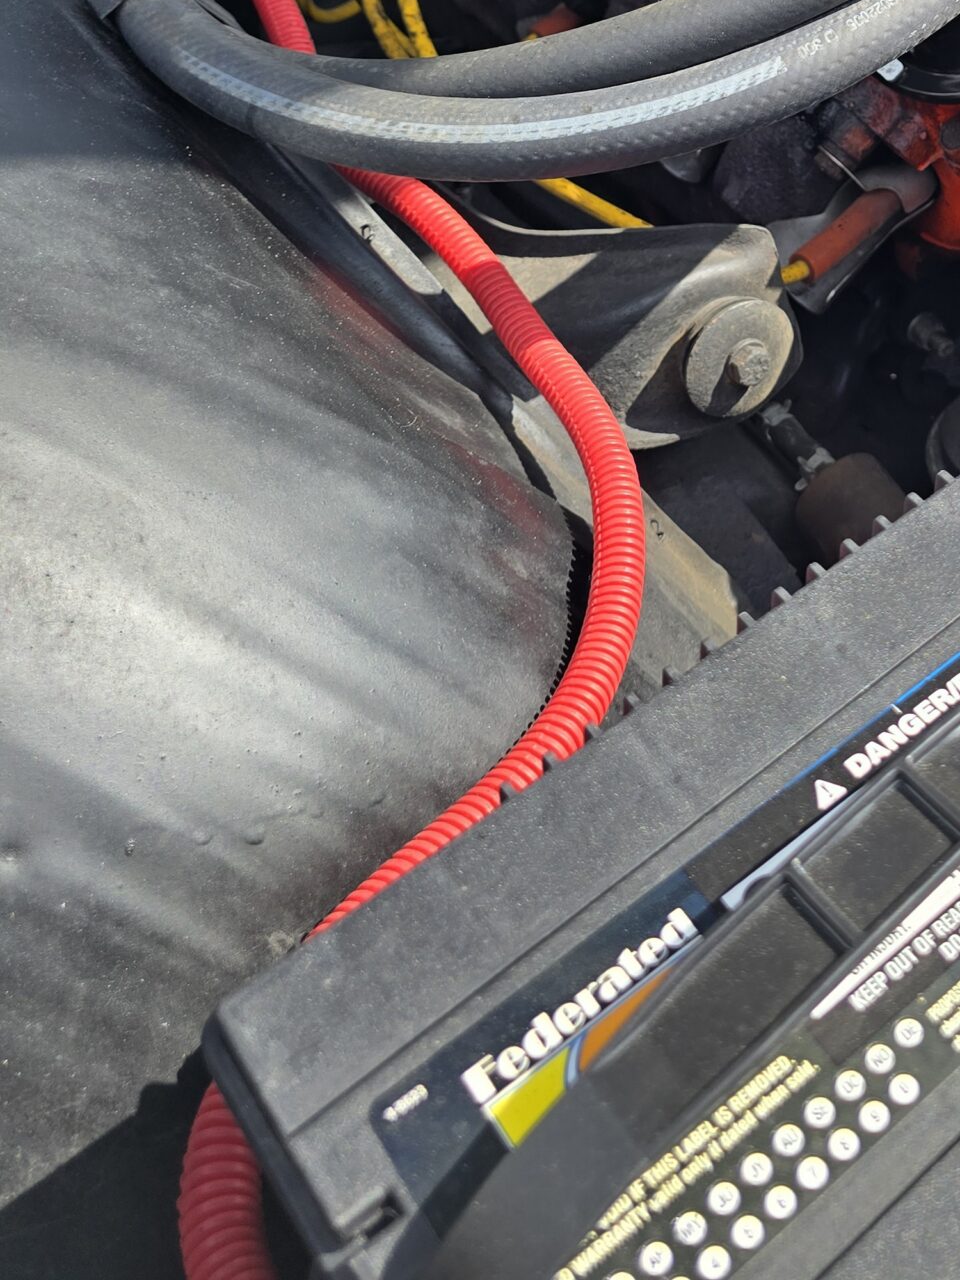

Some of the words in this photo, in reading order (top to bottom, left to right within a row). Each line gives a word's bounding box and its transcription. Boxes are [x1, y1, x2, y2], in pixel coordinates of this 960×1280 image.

[461, 907, 698, 1104] Federated
[846, 970, 894, 1012] KEEP
[881, 946, 921, 981] OUT
[910, 929, 941, 956] OF
[568, 1202, 656, 1278] WARRANTY
[643, 1175, 687, 1214] valid
[676, 1151, 718, 1188] only
[714, 1110, 760, 1150] dated
[749, 1081, 792, 1120] when
[781, 1056, 821, 1091] sold.
[624, 1179, 650, 1202] IF
[640, 1152, 682, 1189] THIS
[671, 1118, 721, 1162] LABEL
[709, 1104, 736, 1129] IS
[725, 1050, 799, 1115] REMOVED.
